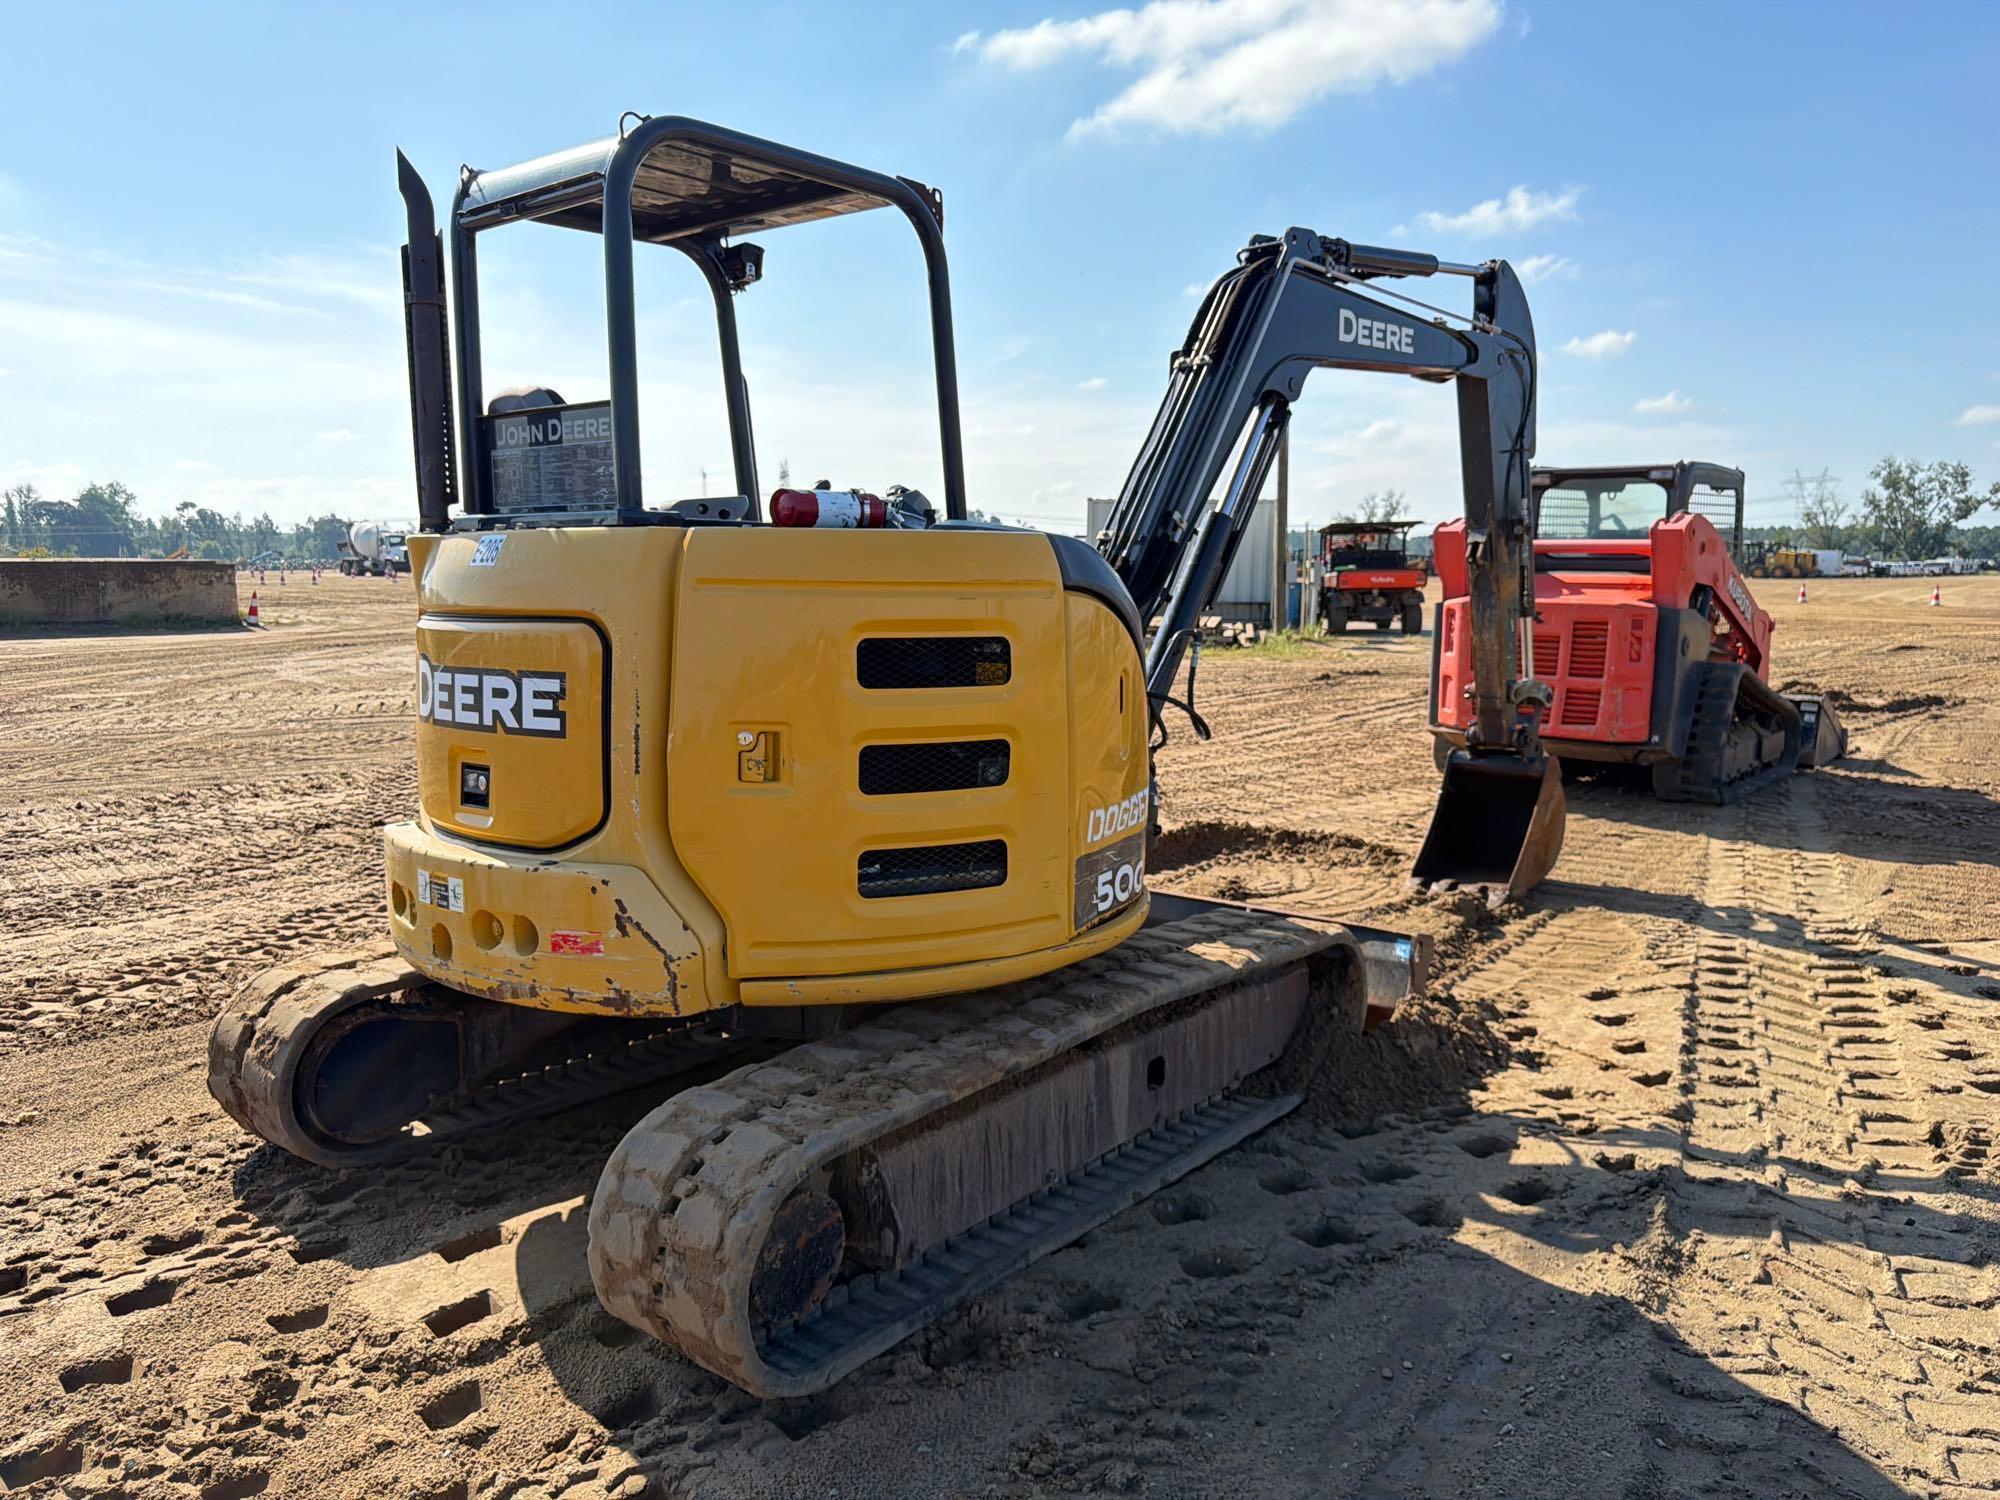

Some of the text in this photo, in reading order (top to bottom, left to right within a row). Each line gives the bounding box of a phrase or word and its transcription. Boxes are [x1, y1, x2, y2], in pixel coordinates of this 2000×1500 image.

[1338, 308, 1415, 354] DEERE
[496, 417, 612, 447] JOHN DEERE
[472, 538, 504, 563] E-205
[418, 659, 561, 731] DEERE
